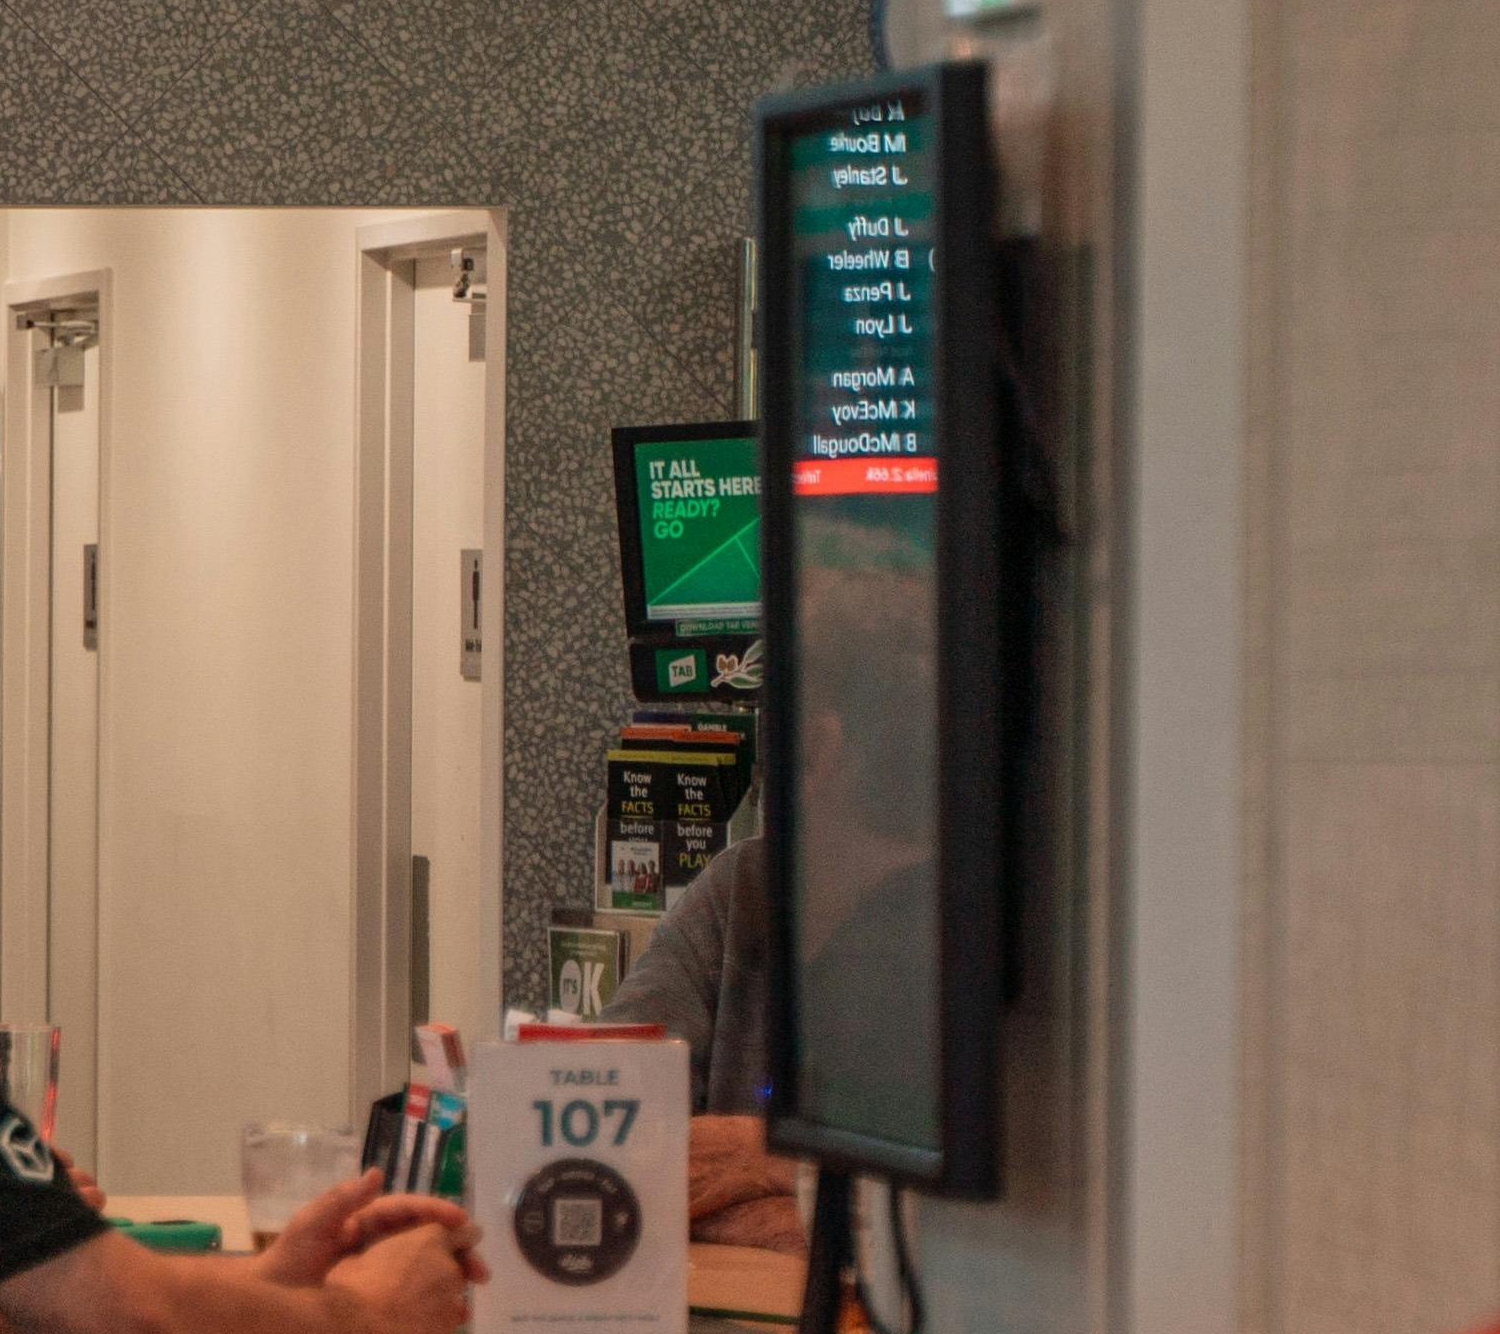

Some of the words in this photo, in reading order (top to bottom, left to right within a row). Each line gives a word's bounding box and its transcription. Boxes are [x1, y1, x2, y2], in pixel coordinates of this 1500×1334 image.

[650, 461, 667, 479] IT
[670, 460, 700, 478] ALL
[651, 478, 716, 499] STARTS
[653, 500, 720, 518] READY?
[655, 520, 683, 538] GO
[677, 774, 706, 786] Know
[678, 804, 711, 816] FACTS
[550, 1069, 619, 1085] TABLE
[534, 1099, 641, 1147] 107
